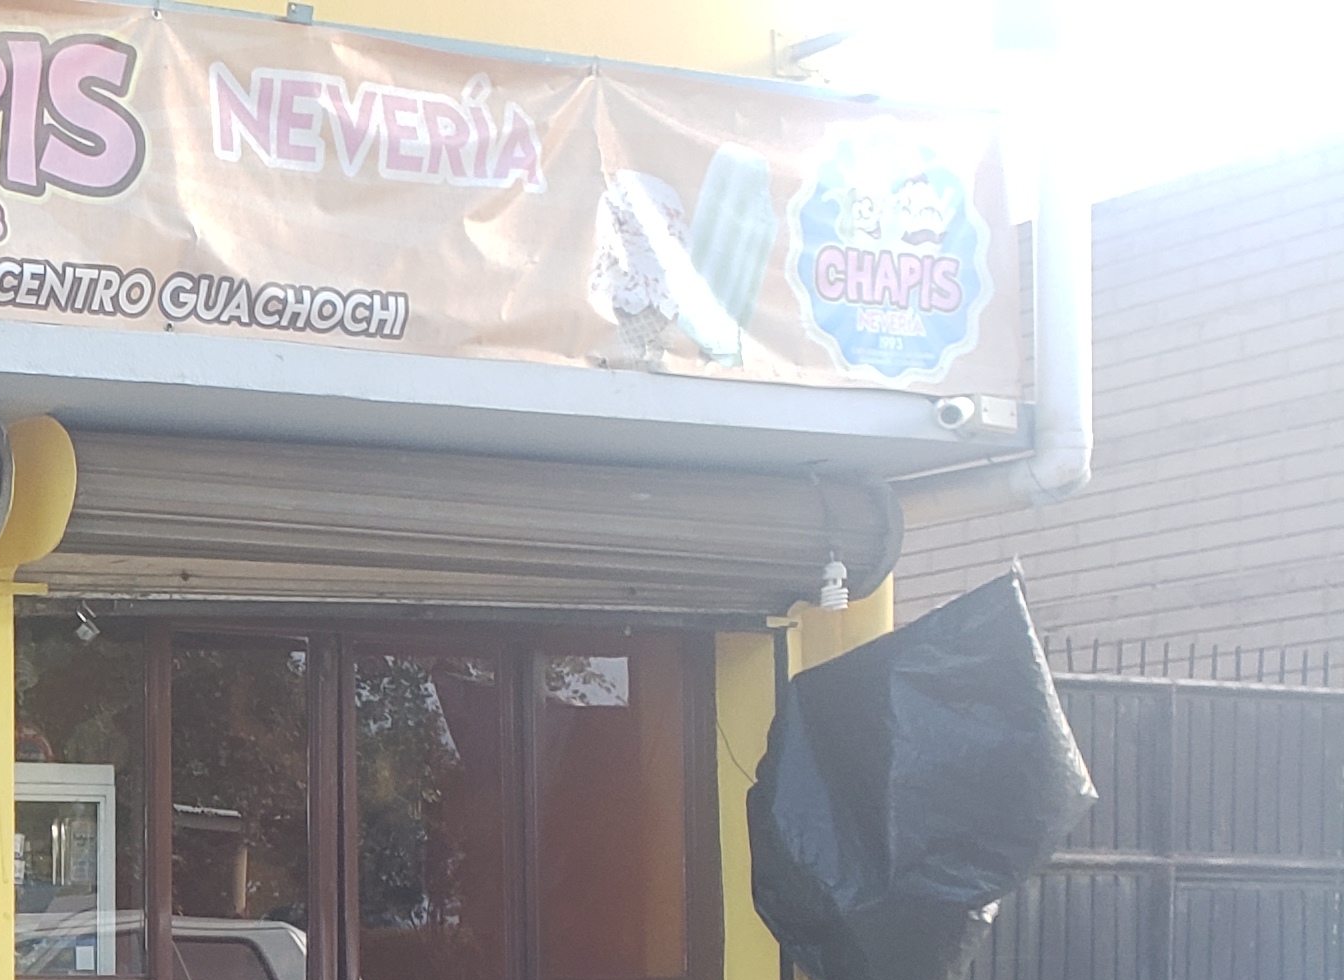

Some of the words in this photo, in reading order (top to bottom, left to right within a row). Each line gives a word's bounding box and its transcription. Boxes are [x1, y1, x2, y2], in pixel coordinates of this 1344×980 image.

[211, 64, 545, 191] NEVERÍA
[158, 270, 411, 340] GUACHOCHI
[815, 245, 963, 313] CHAPIS
